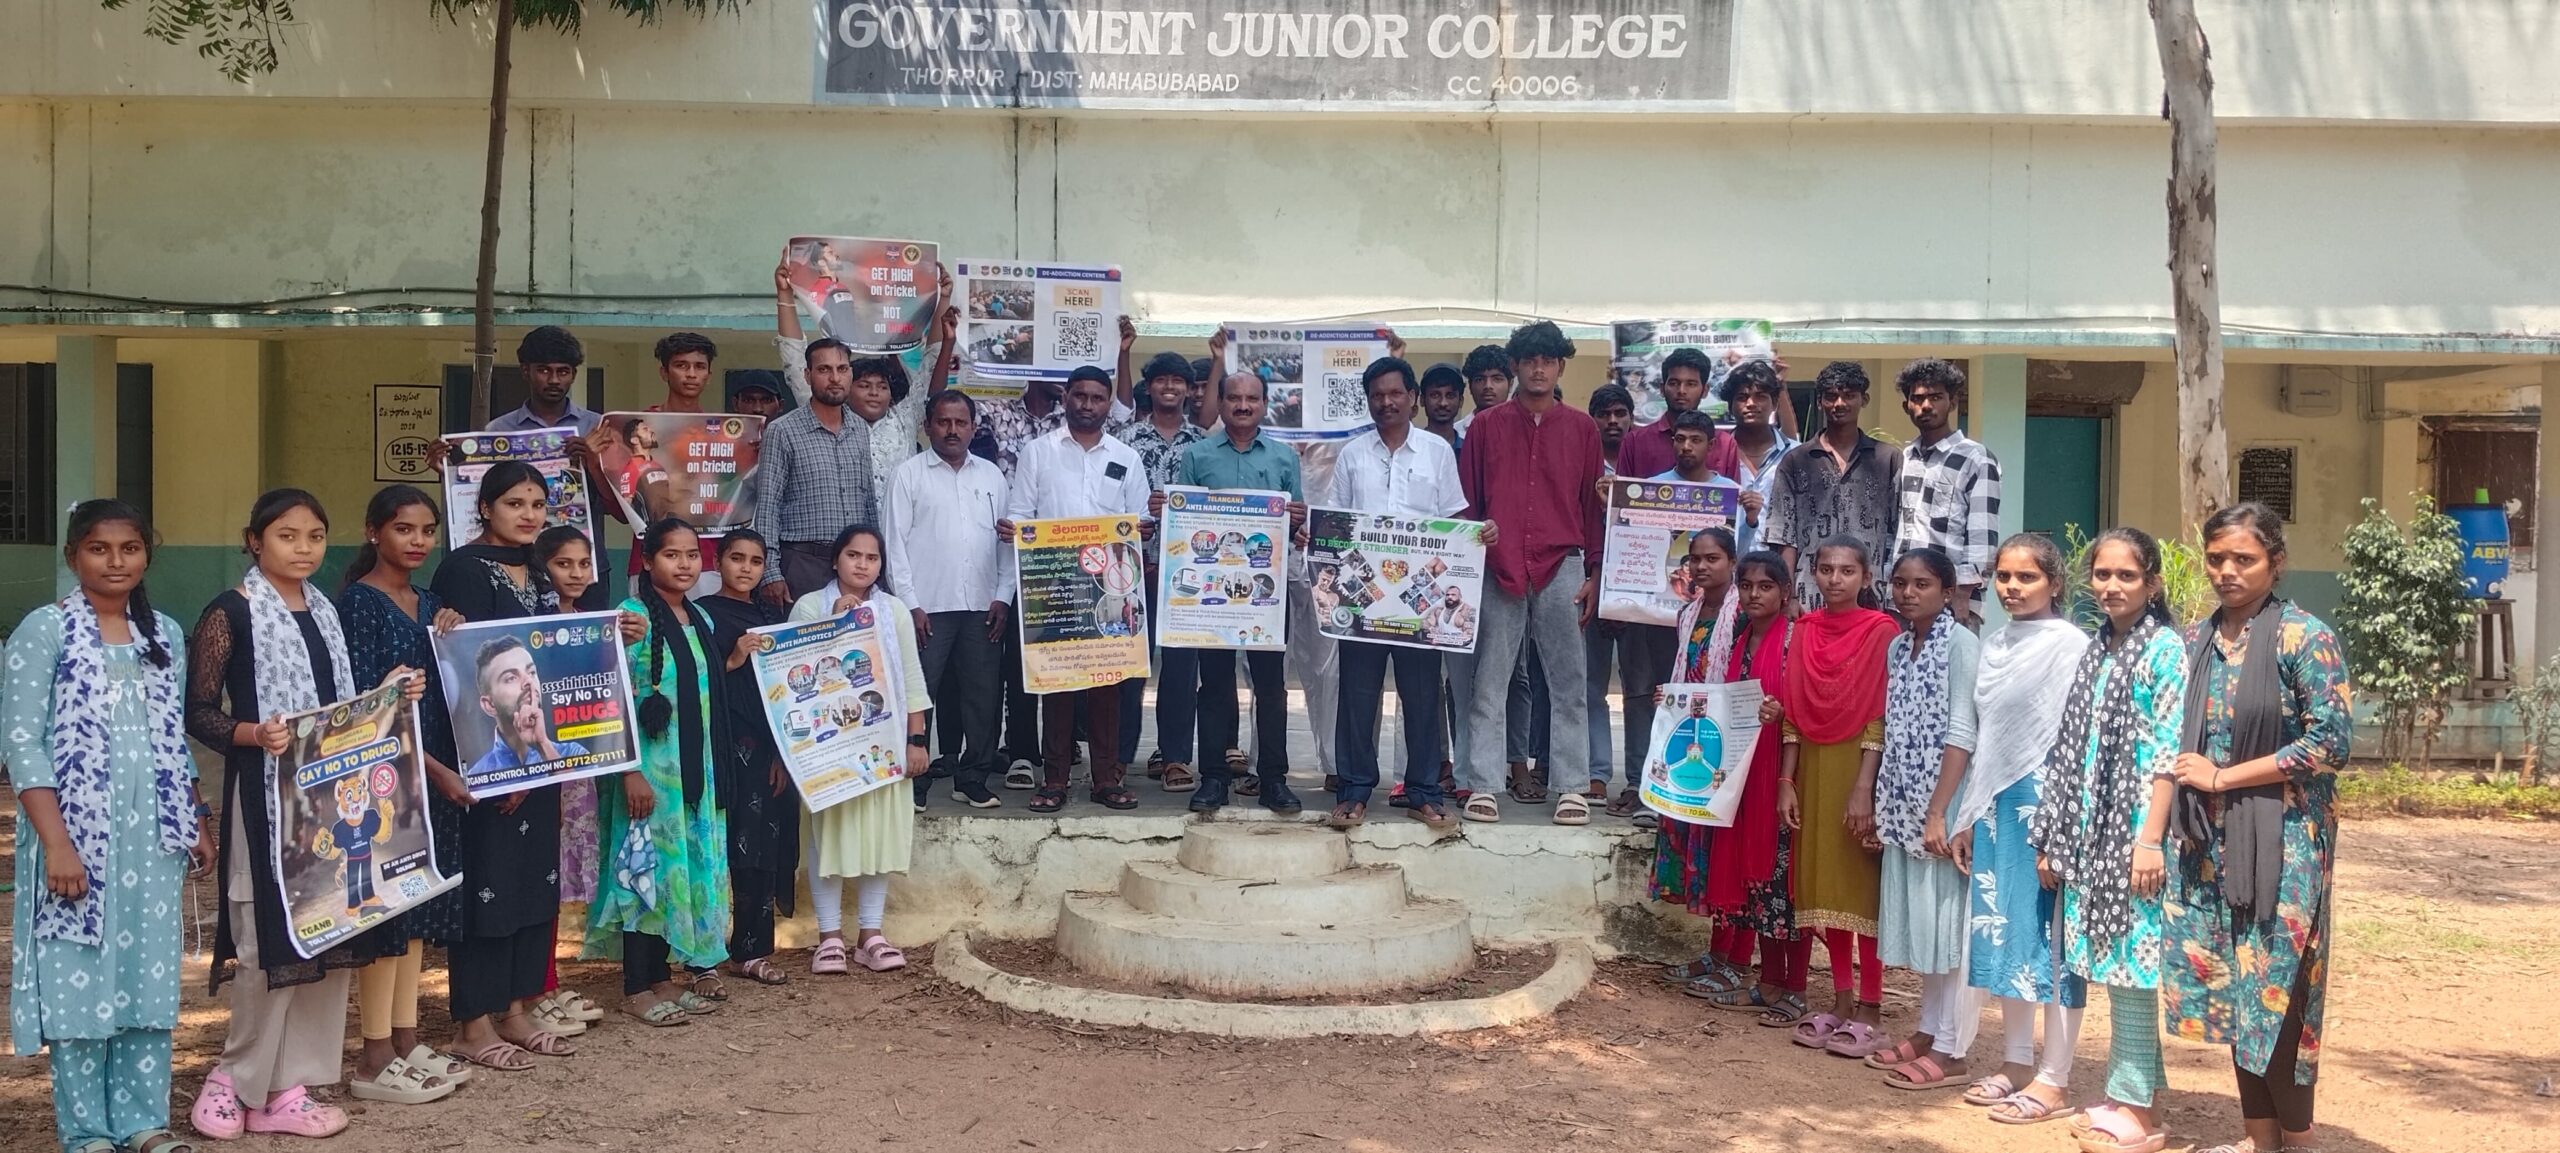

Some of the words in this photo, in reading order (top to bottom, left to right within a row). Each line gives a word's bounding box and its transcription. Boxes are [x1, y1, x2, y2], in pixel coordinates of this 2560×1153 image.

[839, 3, 1196, 55] GOVERNMENT
[1207, 12, 1408, 58] JUNIOR
[1427, 14, 1687, 59] COLLEGE
[1031, 70, 1083, 89] DIST:
[1090, 71, 1239, 92] MAHABUBABAD
[1448, 76, 1482, 95] CC
[1492, 75, 1578, 95] 40006
[871, 267, 888, 281] GET
[891, 268, 913, 282] HIGH
[1042, 270, 1081, 278] DE-ADDICTION
[1082, 271, 1105, 279] CENTERS
[871, 285, 882, 296] on
[885, 284, 917, 297] Cricket
[1066, 288, 1090, 296] SCAN
[1064, 296, 1093, 306] HERE!
[883, 306, 901, 319] NOT
[874, 323, 886, 333] on
[1660, 335, 1685, 344] BUILD
[1687, 334, 1710, 343] YOUR
[1333, 358, 1361, 367] HERE!
[689, 443, 707, 457] GET
[710, 443, 734, 457] HIGH
[400, 460, 416, 472] 25
[687, 462, 700, 473] on
[702, 461, 736, 473] Cricket
[700, 484, 718, 497] NOT
[1208, 495, 1244, 504] TELANGANA
[690, 503, 702, 514] on
[1052, 524, 1099, 534] తెలంగాణ
[1315, 538, 1326, 546] TO
[1328, 538, 1361, 549] BECOME
[1364, 543, 1409, 555] STRONGER
[1360, 531, 1388, 544] BUILD
[1392, 533, 1418, 547] YOUR
[1420, 537, 1447, 550] BODY
[797, 623, 836, 635] TELANGANA
[776, 641, 792, 650] ANTI
[794, 632, 832, 646] NARCOTICS
[1090, 671, 1123, 683] 1908
[552, 693, 572, 706] Say
[575, 689, 592, 701] No
[594, 687, 612, 699] To
[553, 700, 619, 725] DRUGS
[300, 766, 322, 784] SAY
[325, 761, 341, 775] NO
[343, 754, 358, 768] TO
[361, 742, 397, 762] DRUGS
[467, 774, 489, 786] TGANB
[489, 768, 527, 782] CONTROL
[529, 763, 552, 775] ROOM
[553, 760, 565, 770] NO
[566, 749, 626, 768] 8712671111
[301, 919, 332, 936] TGANB
[307, 936, 325, 946] TOLL
